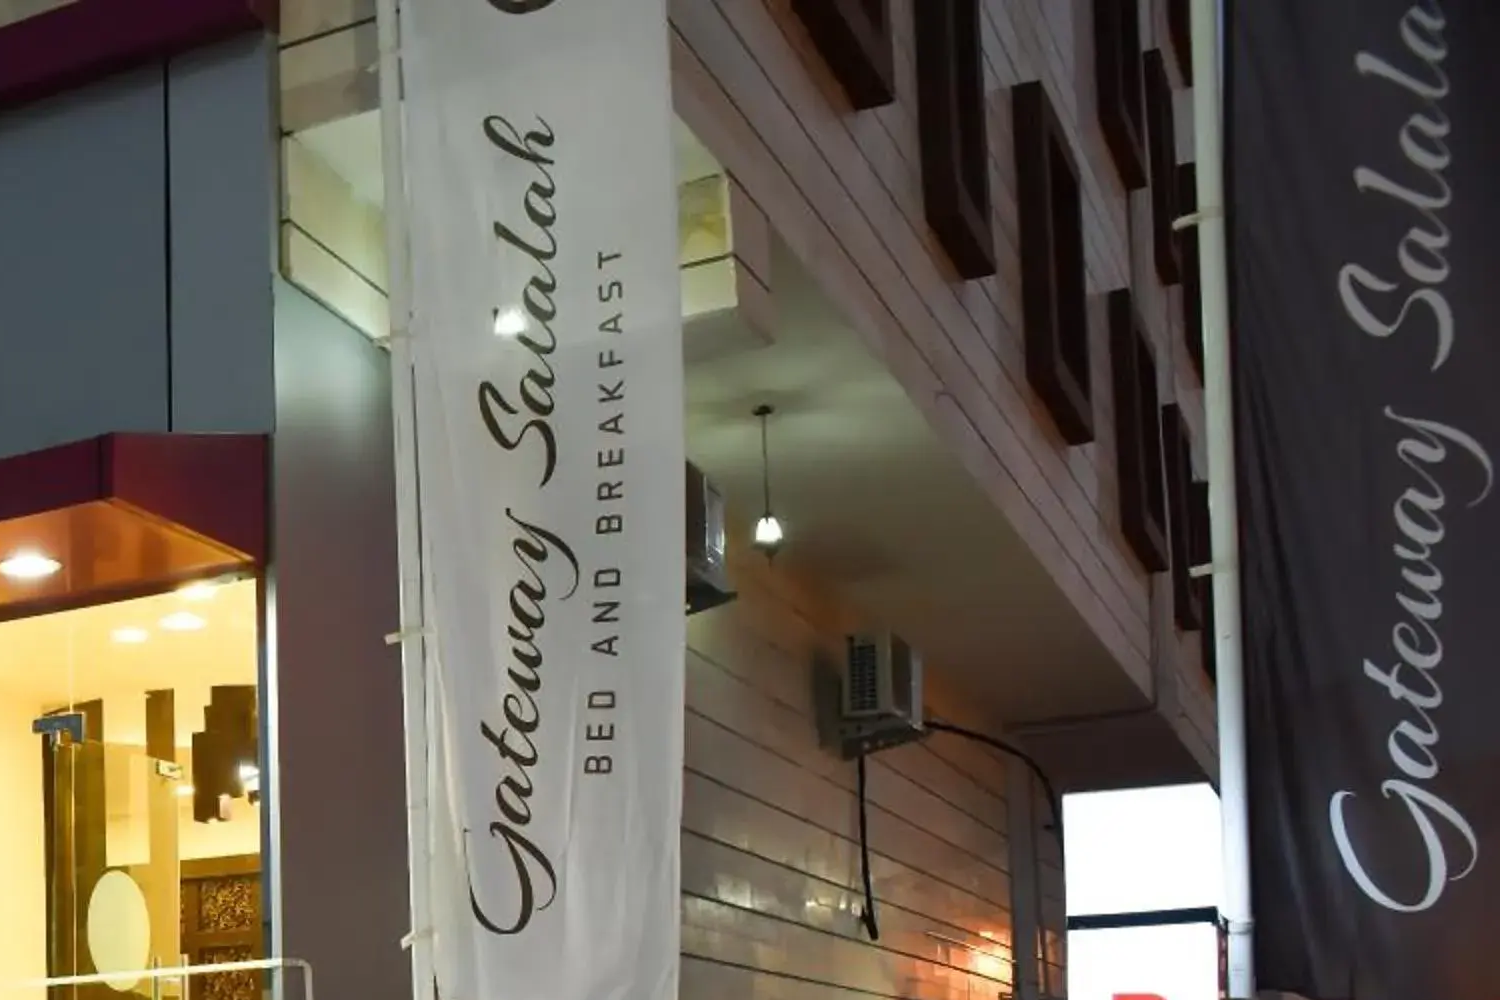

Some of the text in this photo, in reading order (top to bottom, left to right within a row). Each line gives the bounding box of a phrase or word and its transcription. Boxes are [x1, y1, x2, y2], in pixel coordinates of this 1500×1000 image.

[584, 250, 625, 775] BED AND BREAKFAST
[1329, 0, 1495, 913] Gateway Salala
[463, 507, 580, 935] Gateway
